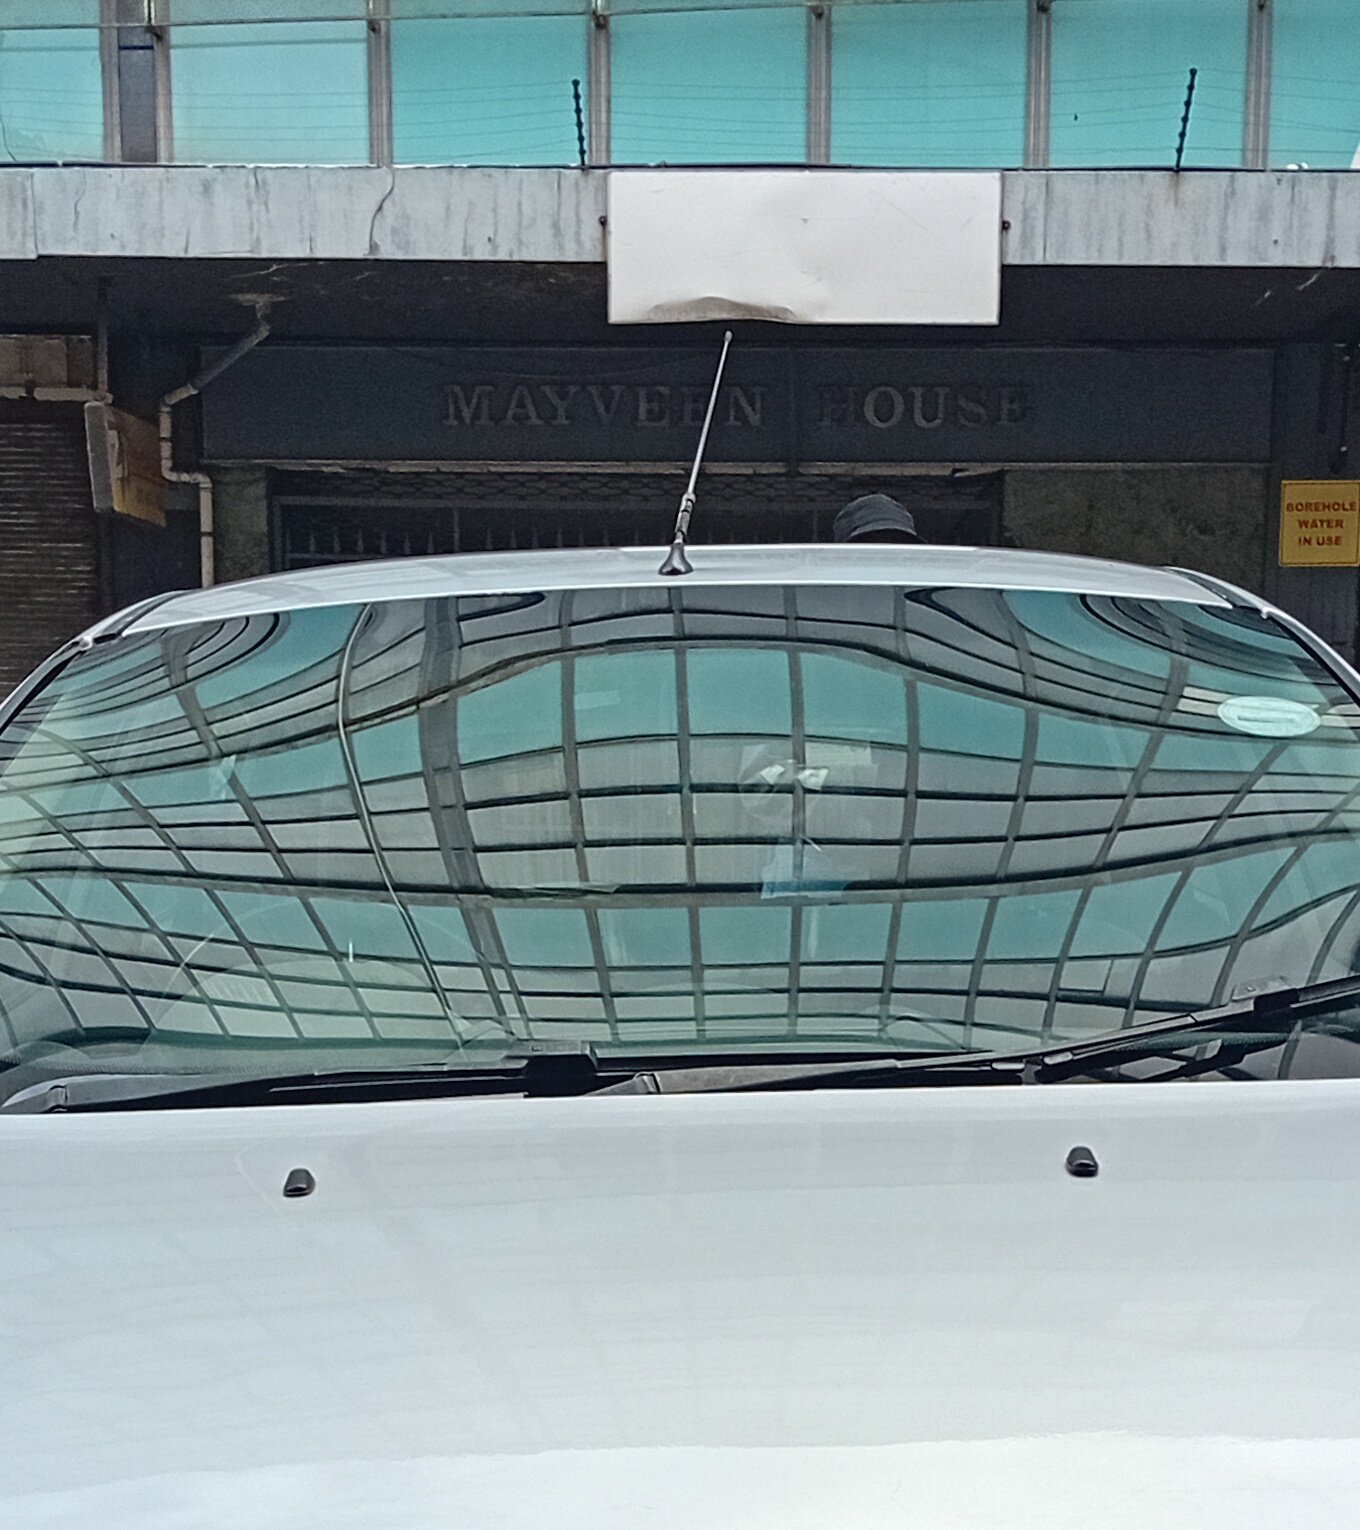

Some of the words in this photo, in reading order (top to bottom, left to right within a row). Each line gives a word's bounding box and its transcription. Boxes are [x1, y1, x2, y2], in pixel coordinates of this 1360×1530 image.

[816, 384, 1034, 428] HOUSE
[1286, 501, 1357, 512] BOREHOLE
[1298, 519, 1344, 529] WATER
[1298, 536, 1312, 546] IN
[1316, 536, 1343, 546] USE
